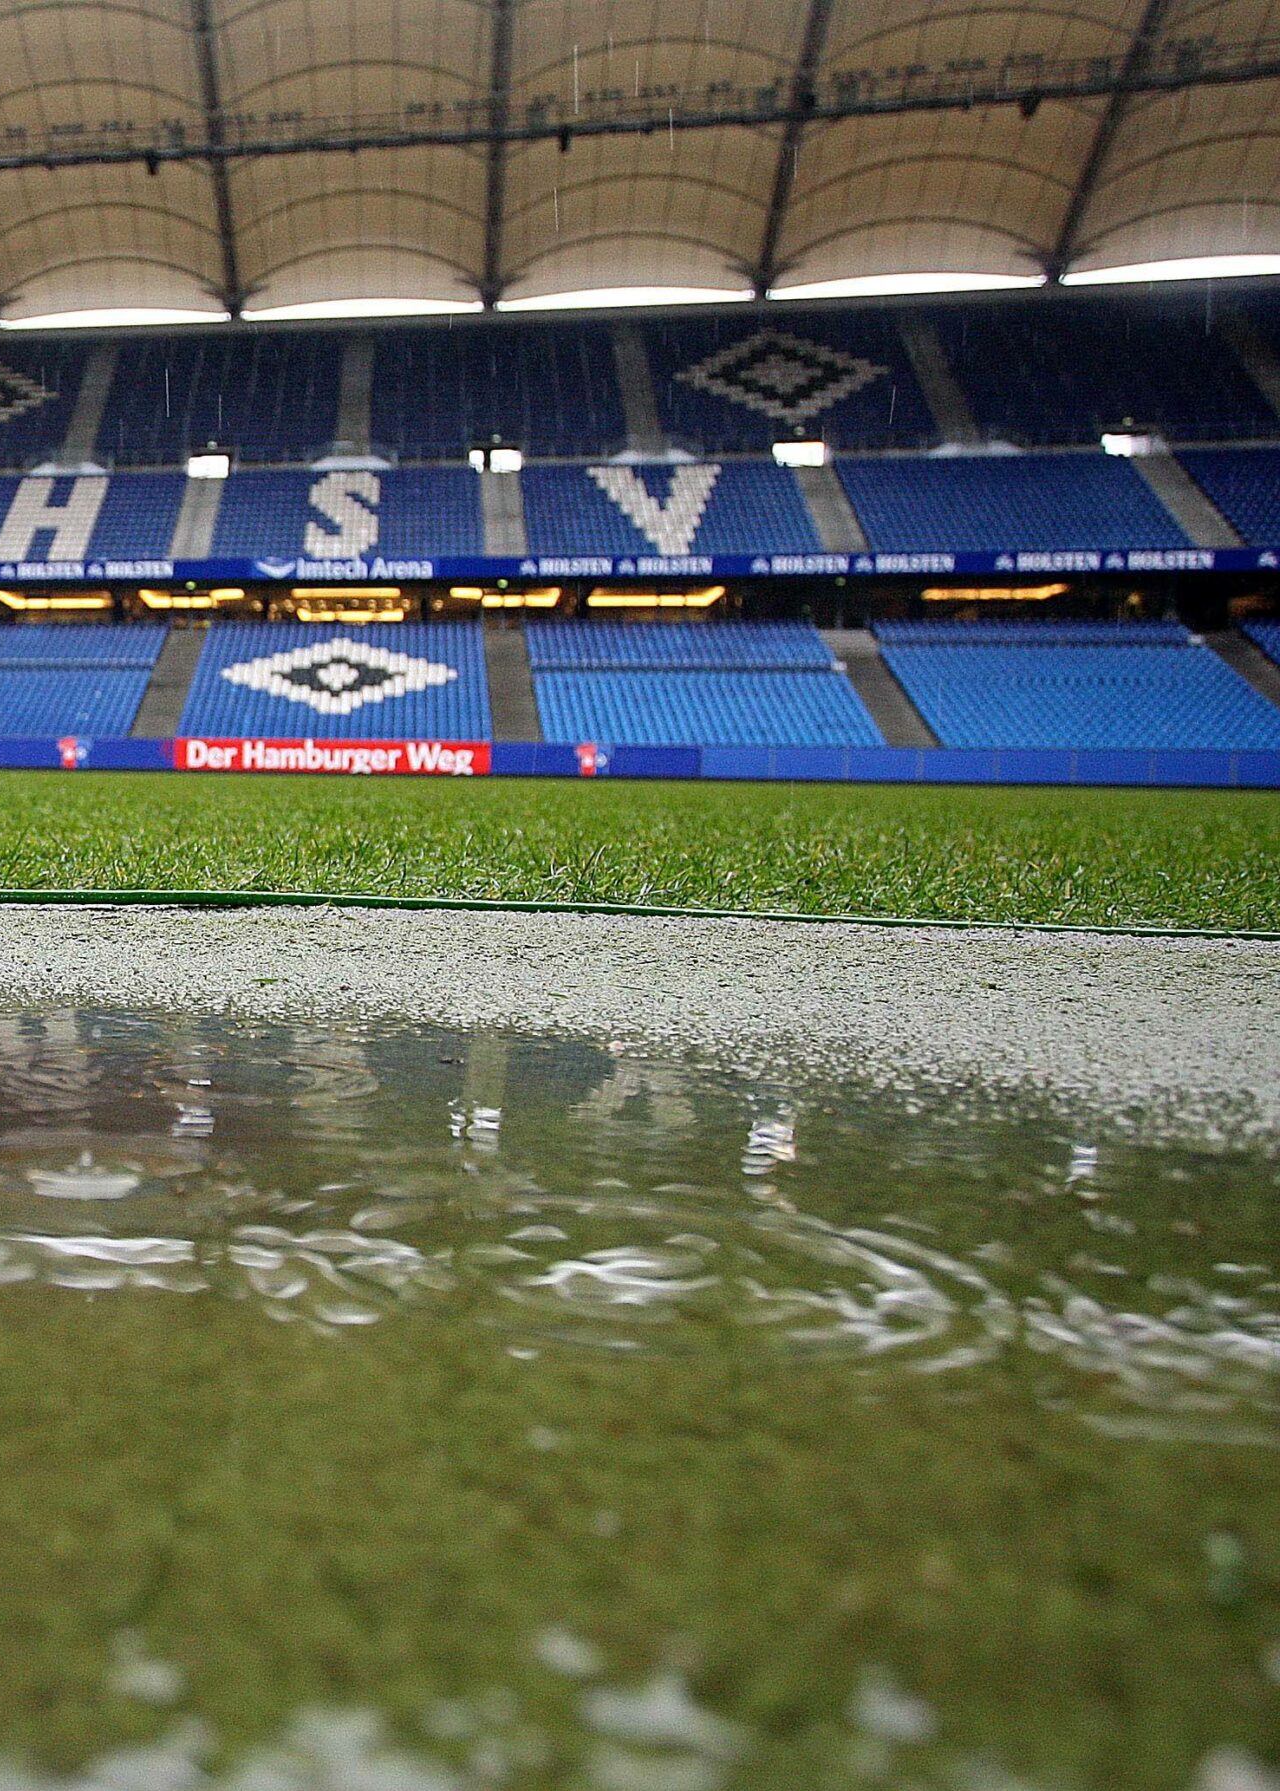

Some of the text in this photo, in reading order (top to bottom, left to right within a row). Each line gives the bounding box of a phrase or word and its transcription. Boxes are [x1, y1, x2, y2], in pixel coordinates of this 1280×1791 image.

[296, 557, 433, 580] Imtech Arena
[539, 556, 712, 576] HOLSTEN HOLSTEN
[771, 553, 954, 574] HOLSTEN HOLSTEN
[1017, 550, 1214, 572] HOLSTEN HOLSTEN
[186, 738, 474, 776] Der Hamburger Weg
